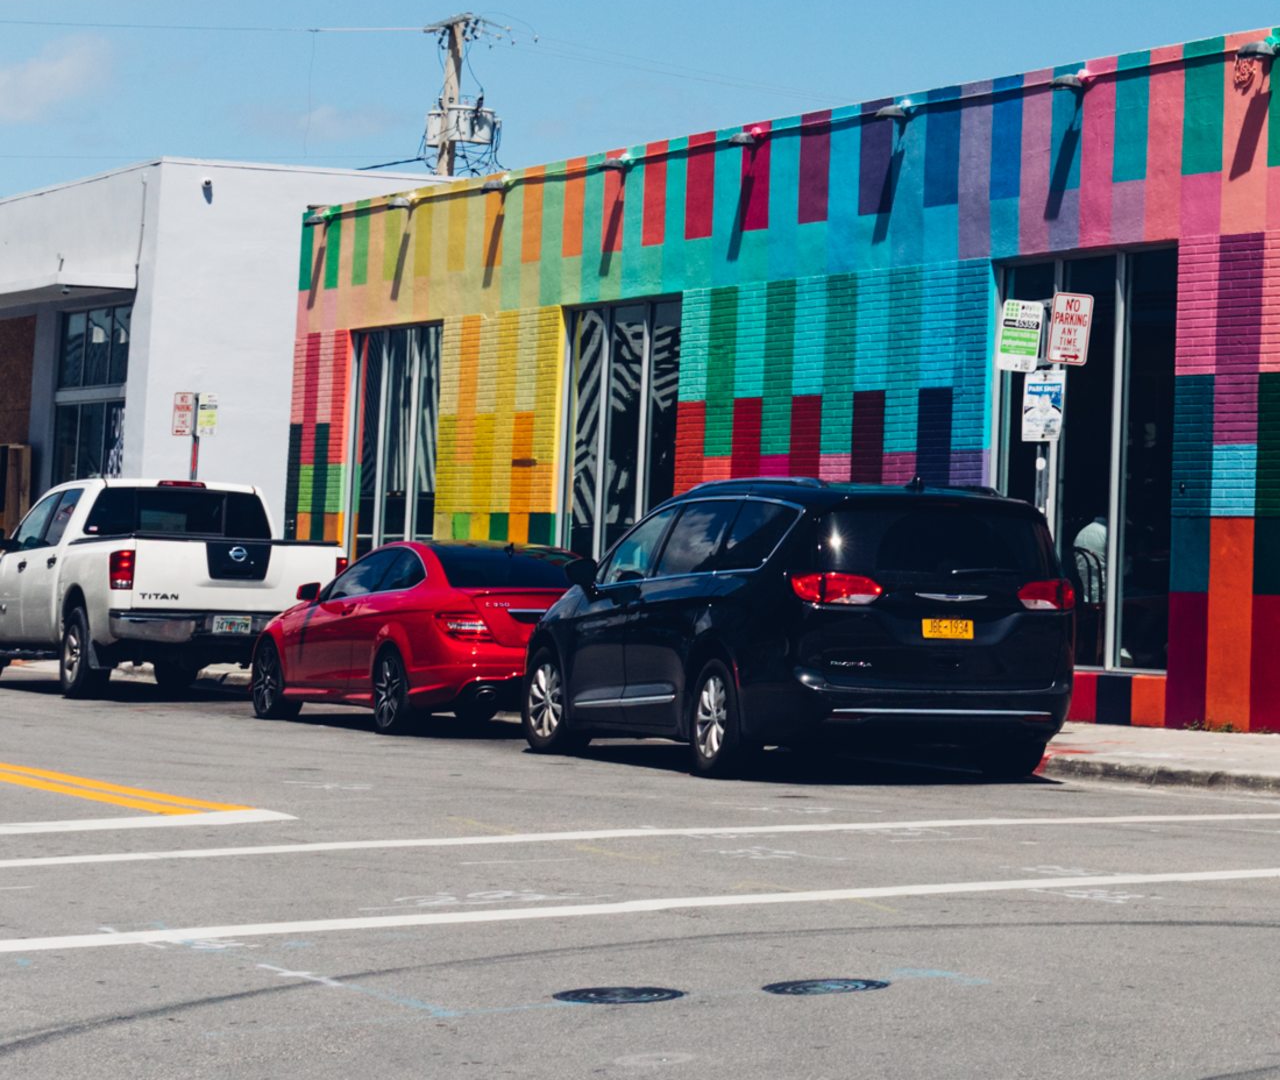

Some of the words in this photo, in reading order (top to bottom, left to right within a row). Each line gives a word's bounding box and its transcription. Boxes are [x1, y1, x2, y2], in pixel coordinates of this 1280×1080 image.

[1065, 299, 1081, 312] NO
[1055, 311, 1088, 327] PARKING
[1061, 327, 1078, 336] ANY
[1059, 336, 1078, 347] TIME
[139, 592, 179, 601] TITAN
[928, 620, 969, 634] JBE-1934
